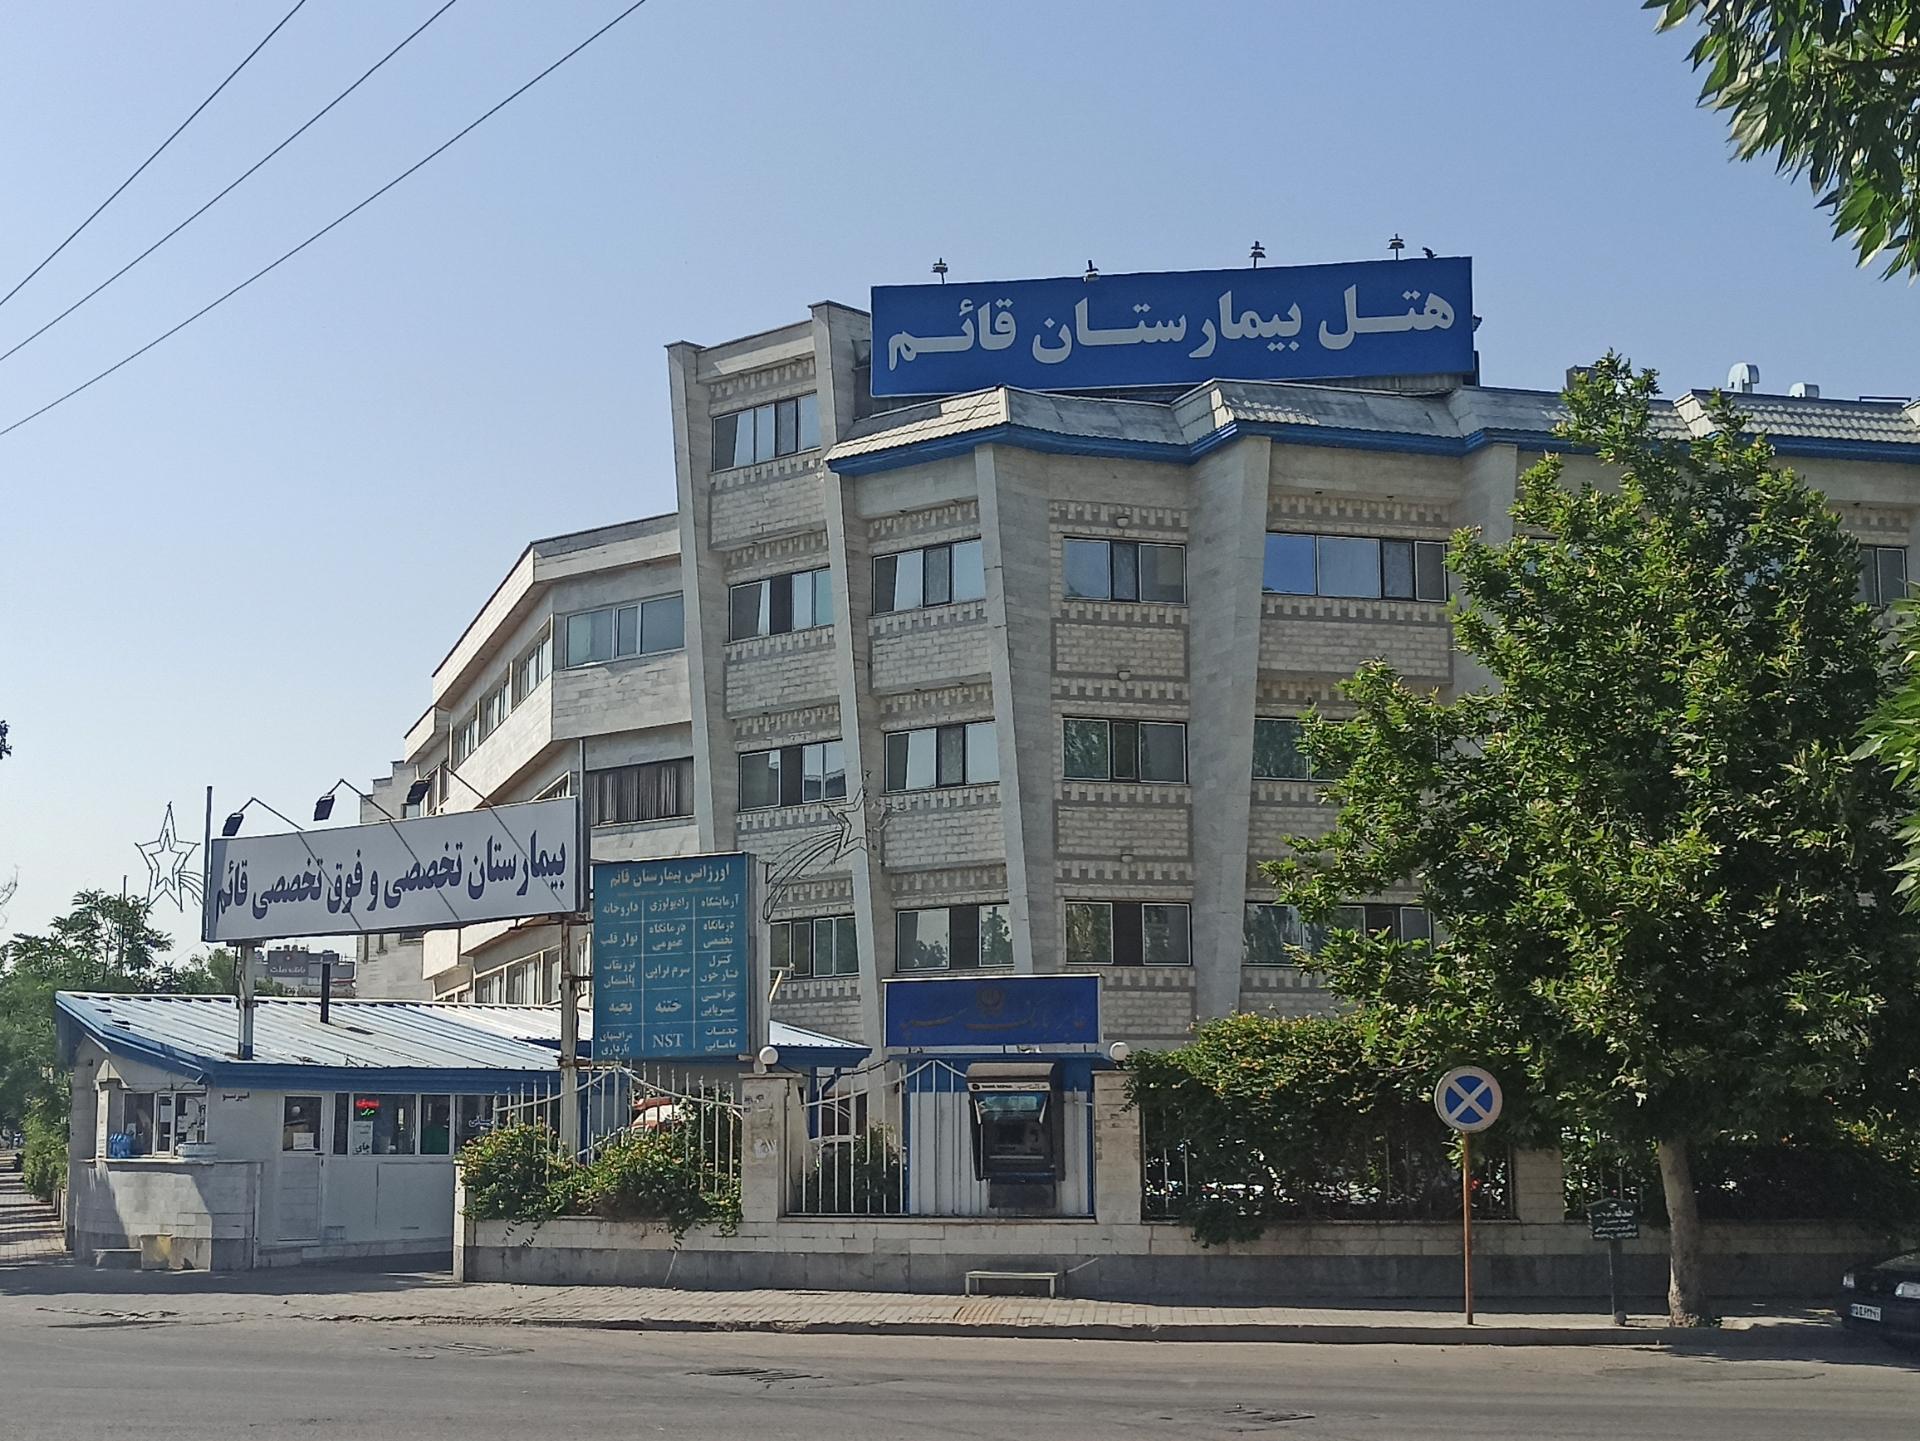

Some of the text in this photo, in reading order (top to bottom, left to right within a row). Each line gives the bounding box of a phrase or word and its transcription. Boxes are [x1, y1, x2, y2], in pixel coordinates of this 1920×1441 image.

[888, 284, 1456, 371] هتل بیمارستان قائم
[215, 830, 566, 922] بیمارستان تخصصی و فوق تخصصی قائم
[633, 867, 681, 887] بیمارستان
[685, 862, 730, 884] اورژانس
[602, 902, 638, 917] داروخانه
[649, 922, 687, 935] درمانگاه
[703, 919, 735, 933] درمانگاه
[655, 998, 682, 1013] ختنه
[653, 1033, 684, 1048] NST
